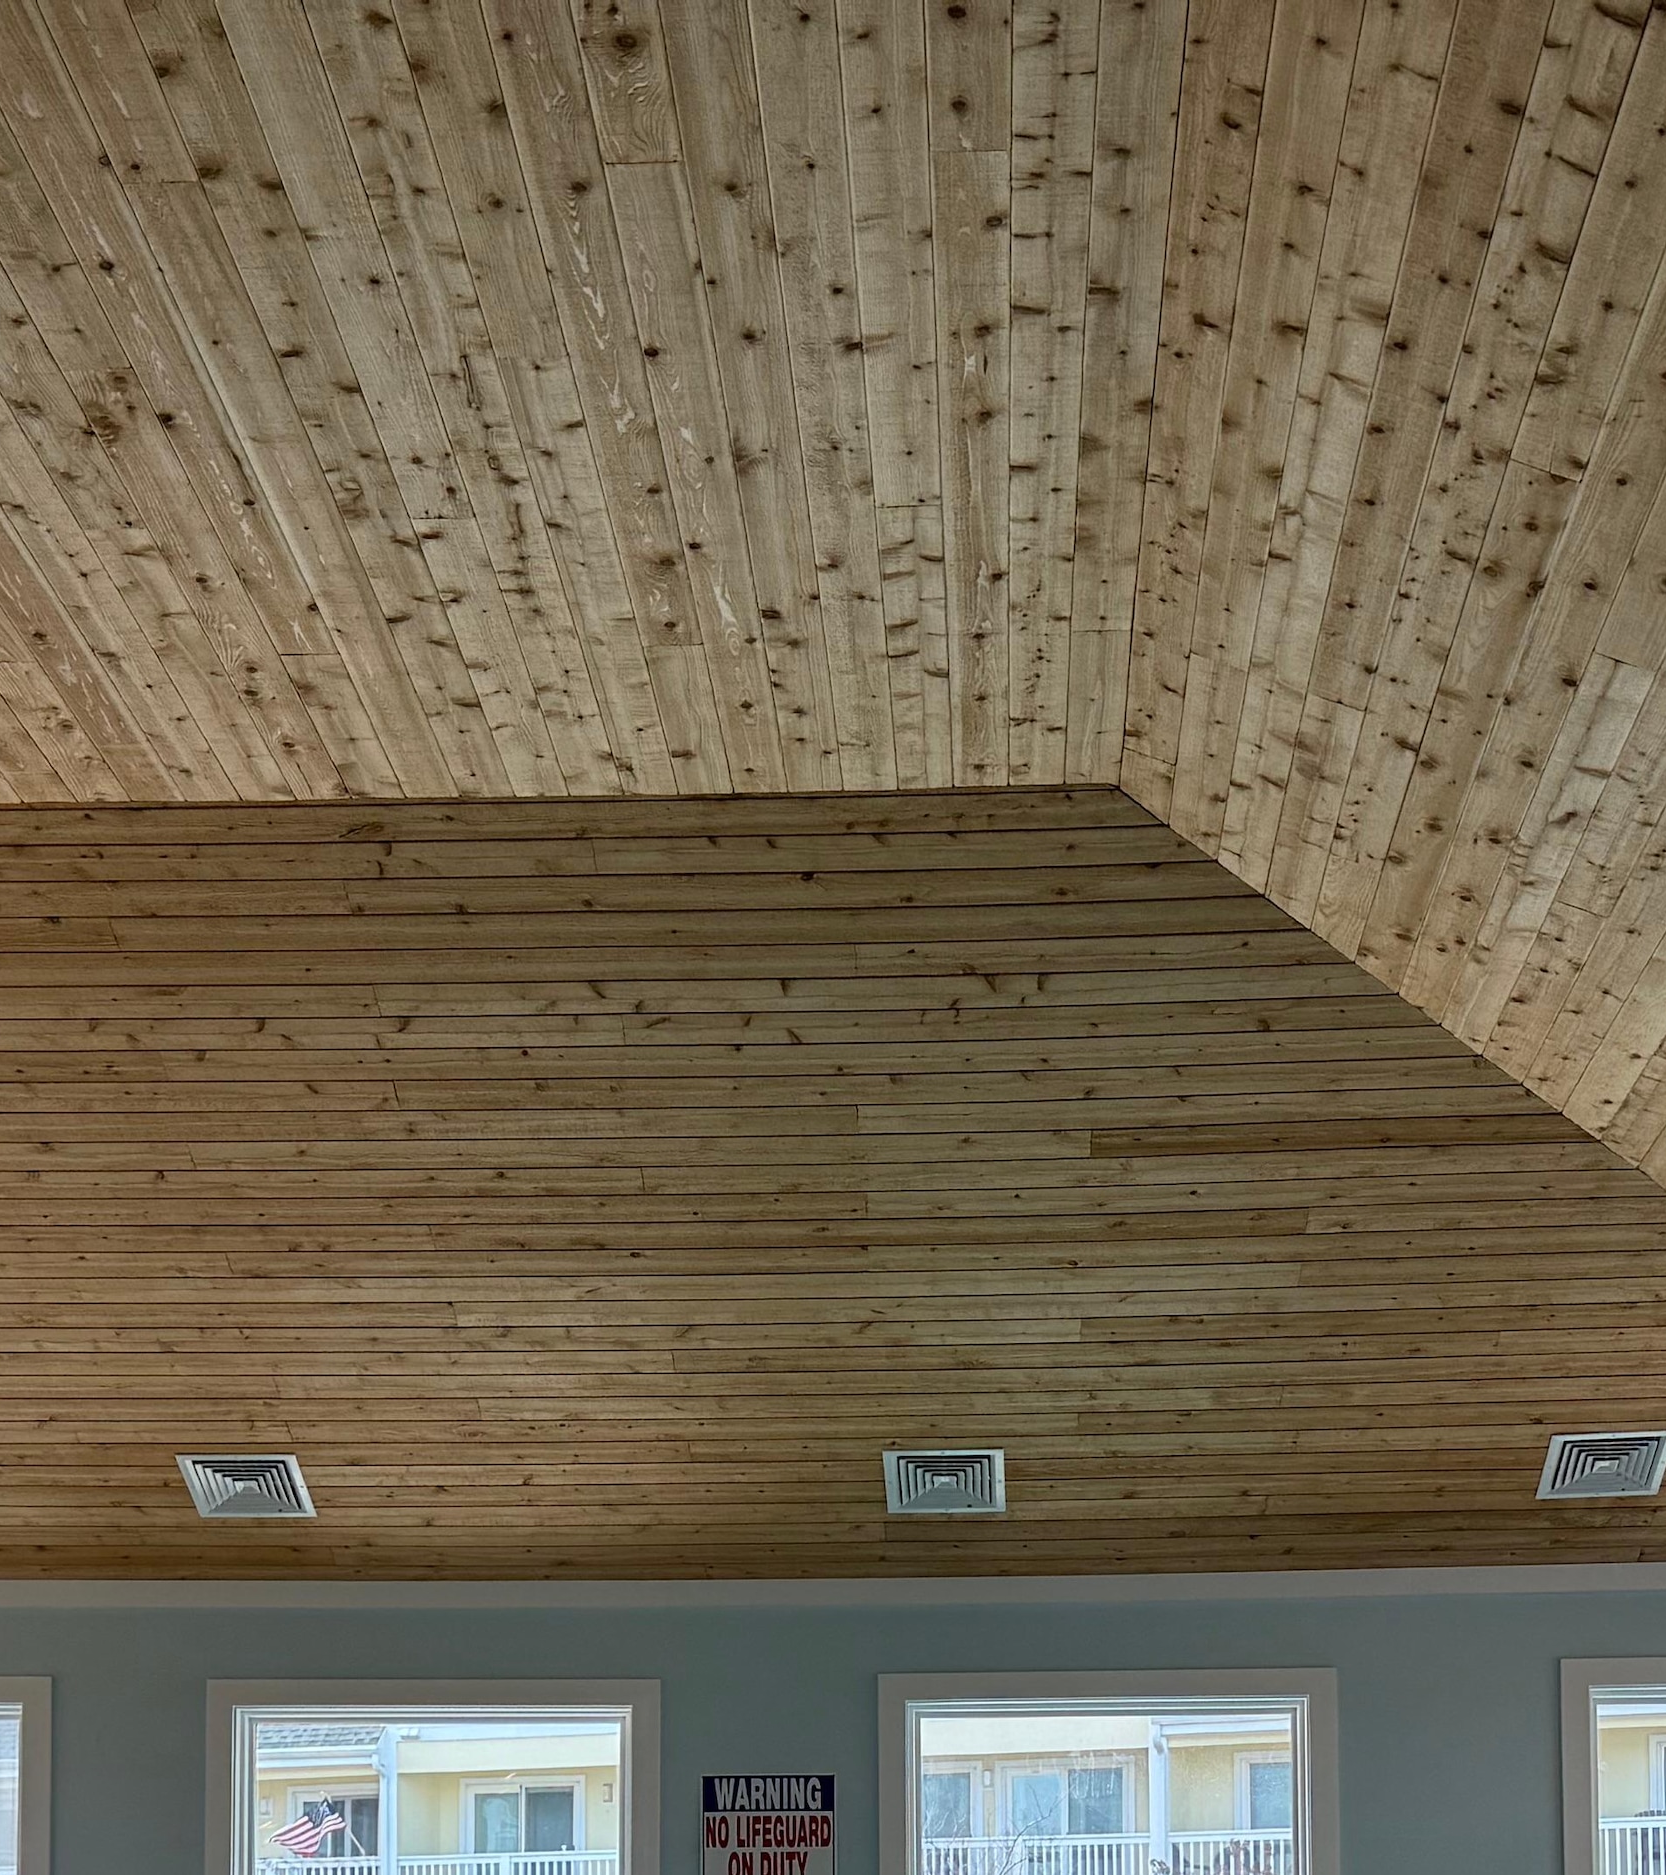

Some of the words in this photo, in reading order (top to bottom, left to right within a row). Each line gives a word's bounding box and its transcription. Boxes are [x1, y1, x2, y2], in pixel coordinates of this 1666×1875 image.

[714, 1777, 821, 1810] WARNING
[706, 1816, 729, 1848] NO
[737, 1815, 831, 1848] LIFEGUARD
